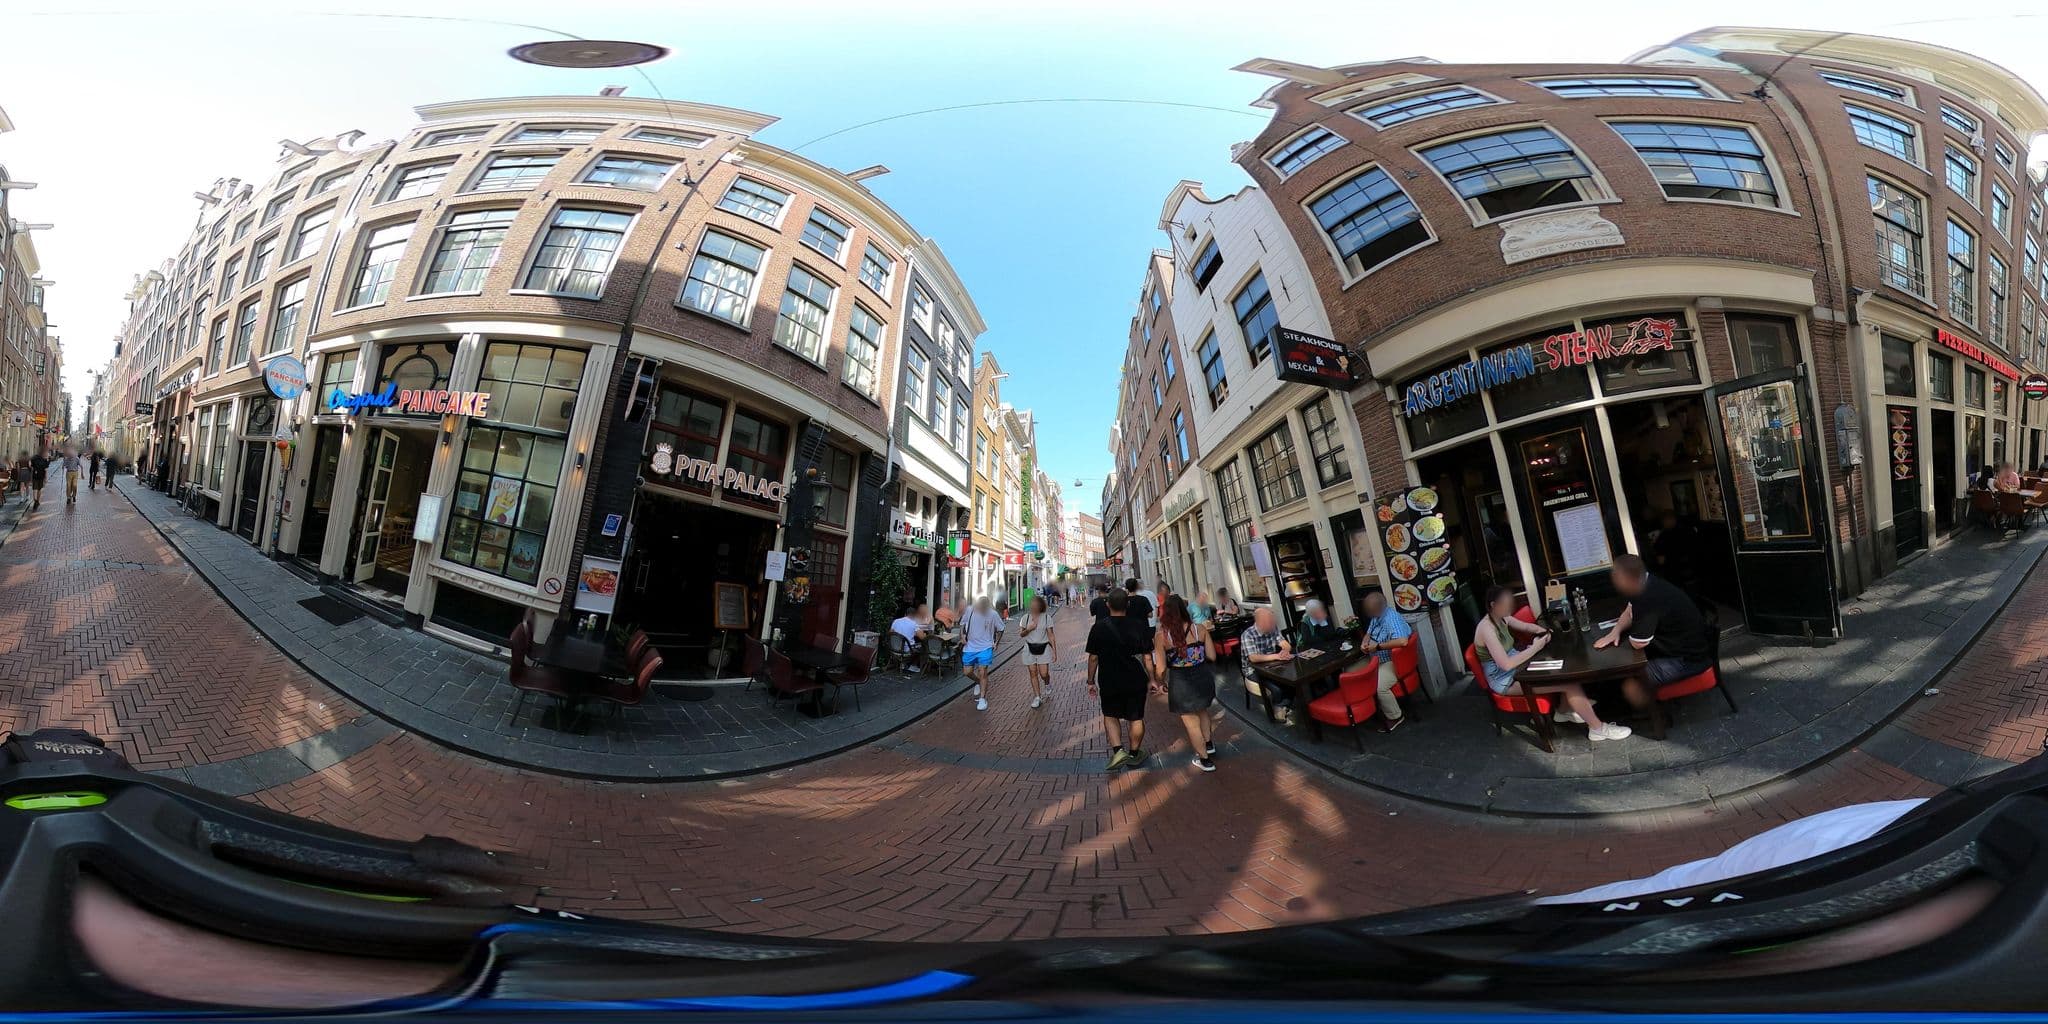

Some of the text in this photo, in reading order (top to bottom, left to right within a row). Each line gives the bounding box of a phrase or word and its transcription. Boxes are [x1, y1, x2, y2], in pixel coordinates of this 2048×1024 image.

[1283, 332, 1344, 352] STEAKHOUSE
[1938, 329, 1982, 361] PIZZERIA
[1315, 355, 1325, 366] &
[1405, 324, 1619, 417] ARGENTINIAN STEAK
[270, 370, 304, 386] PANCAKE
[328, 382, 491, 418] Original PANCAKE
[674, 454, 788, 503] PITA PALACE
